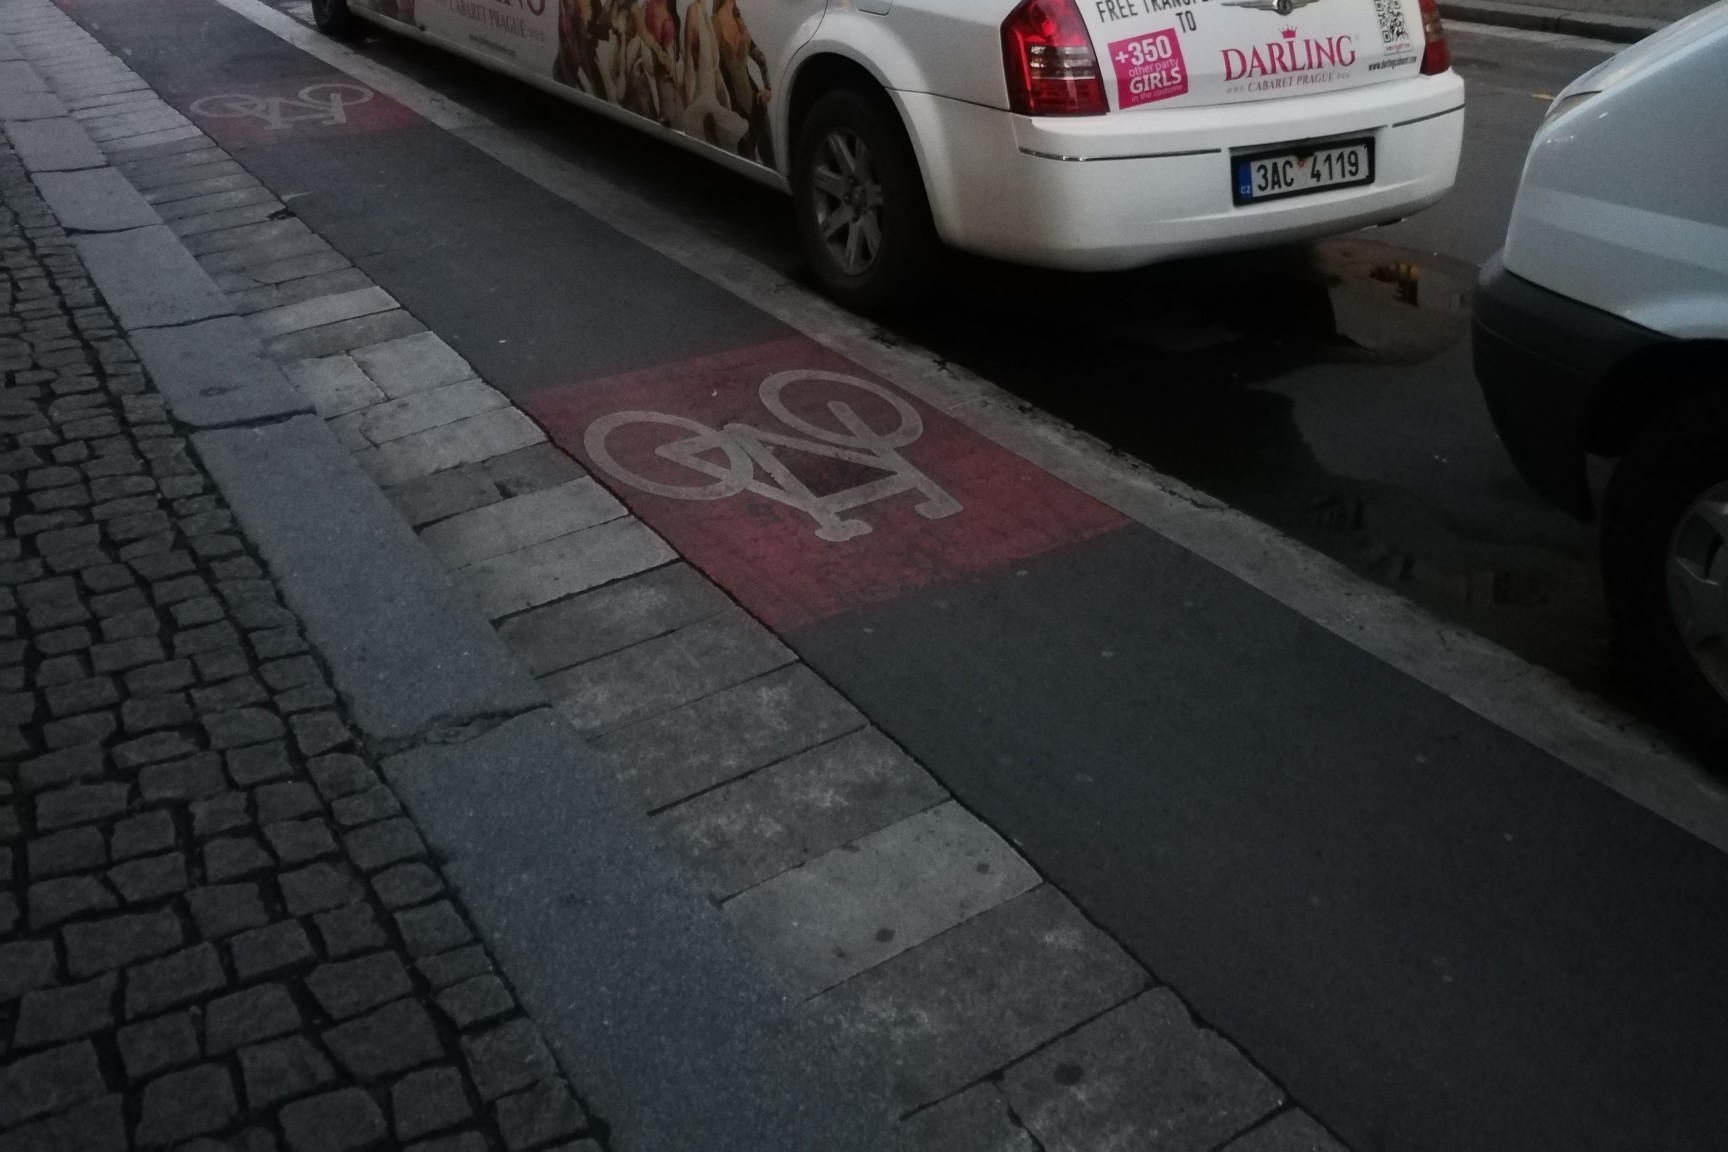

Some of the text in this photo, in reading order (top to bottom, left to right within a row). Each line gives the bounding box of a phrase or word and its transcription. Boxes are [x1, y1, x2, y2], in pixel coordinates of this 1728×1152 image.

[488, 8, 526, 38] PRAGUE
[1175, 10, 1197, 33] TO
[1115, 35, 1172, 65] +350
[1220, 35, 1356, 82] DARLING
[1128, 58, 1178, 77] other party
[1129, 66, 1182, 94] GIRLS
[1248, 72, 1334, 93] CABARET PRAGUE
[1256, 150, 1359, 192] 3AC 4119
[1240, 185, 1252, 195] CZ
